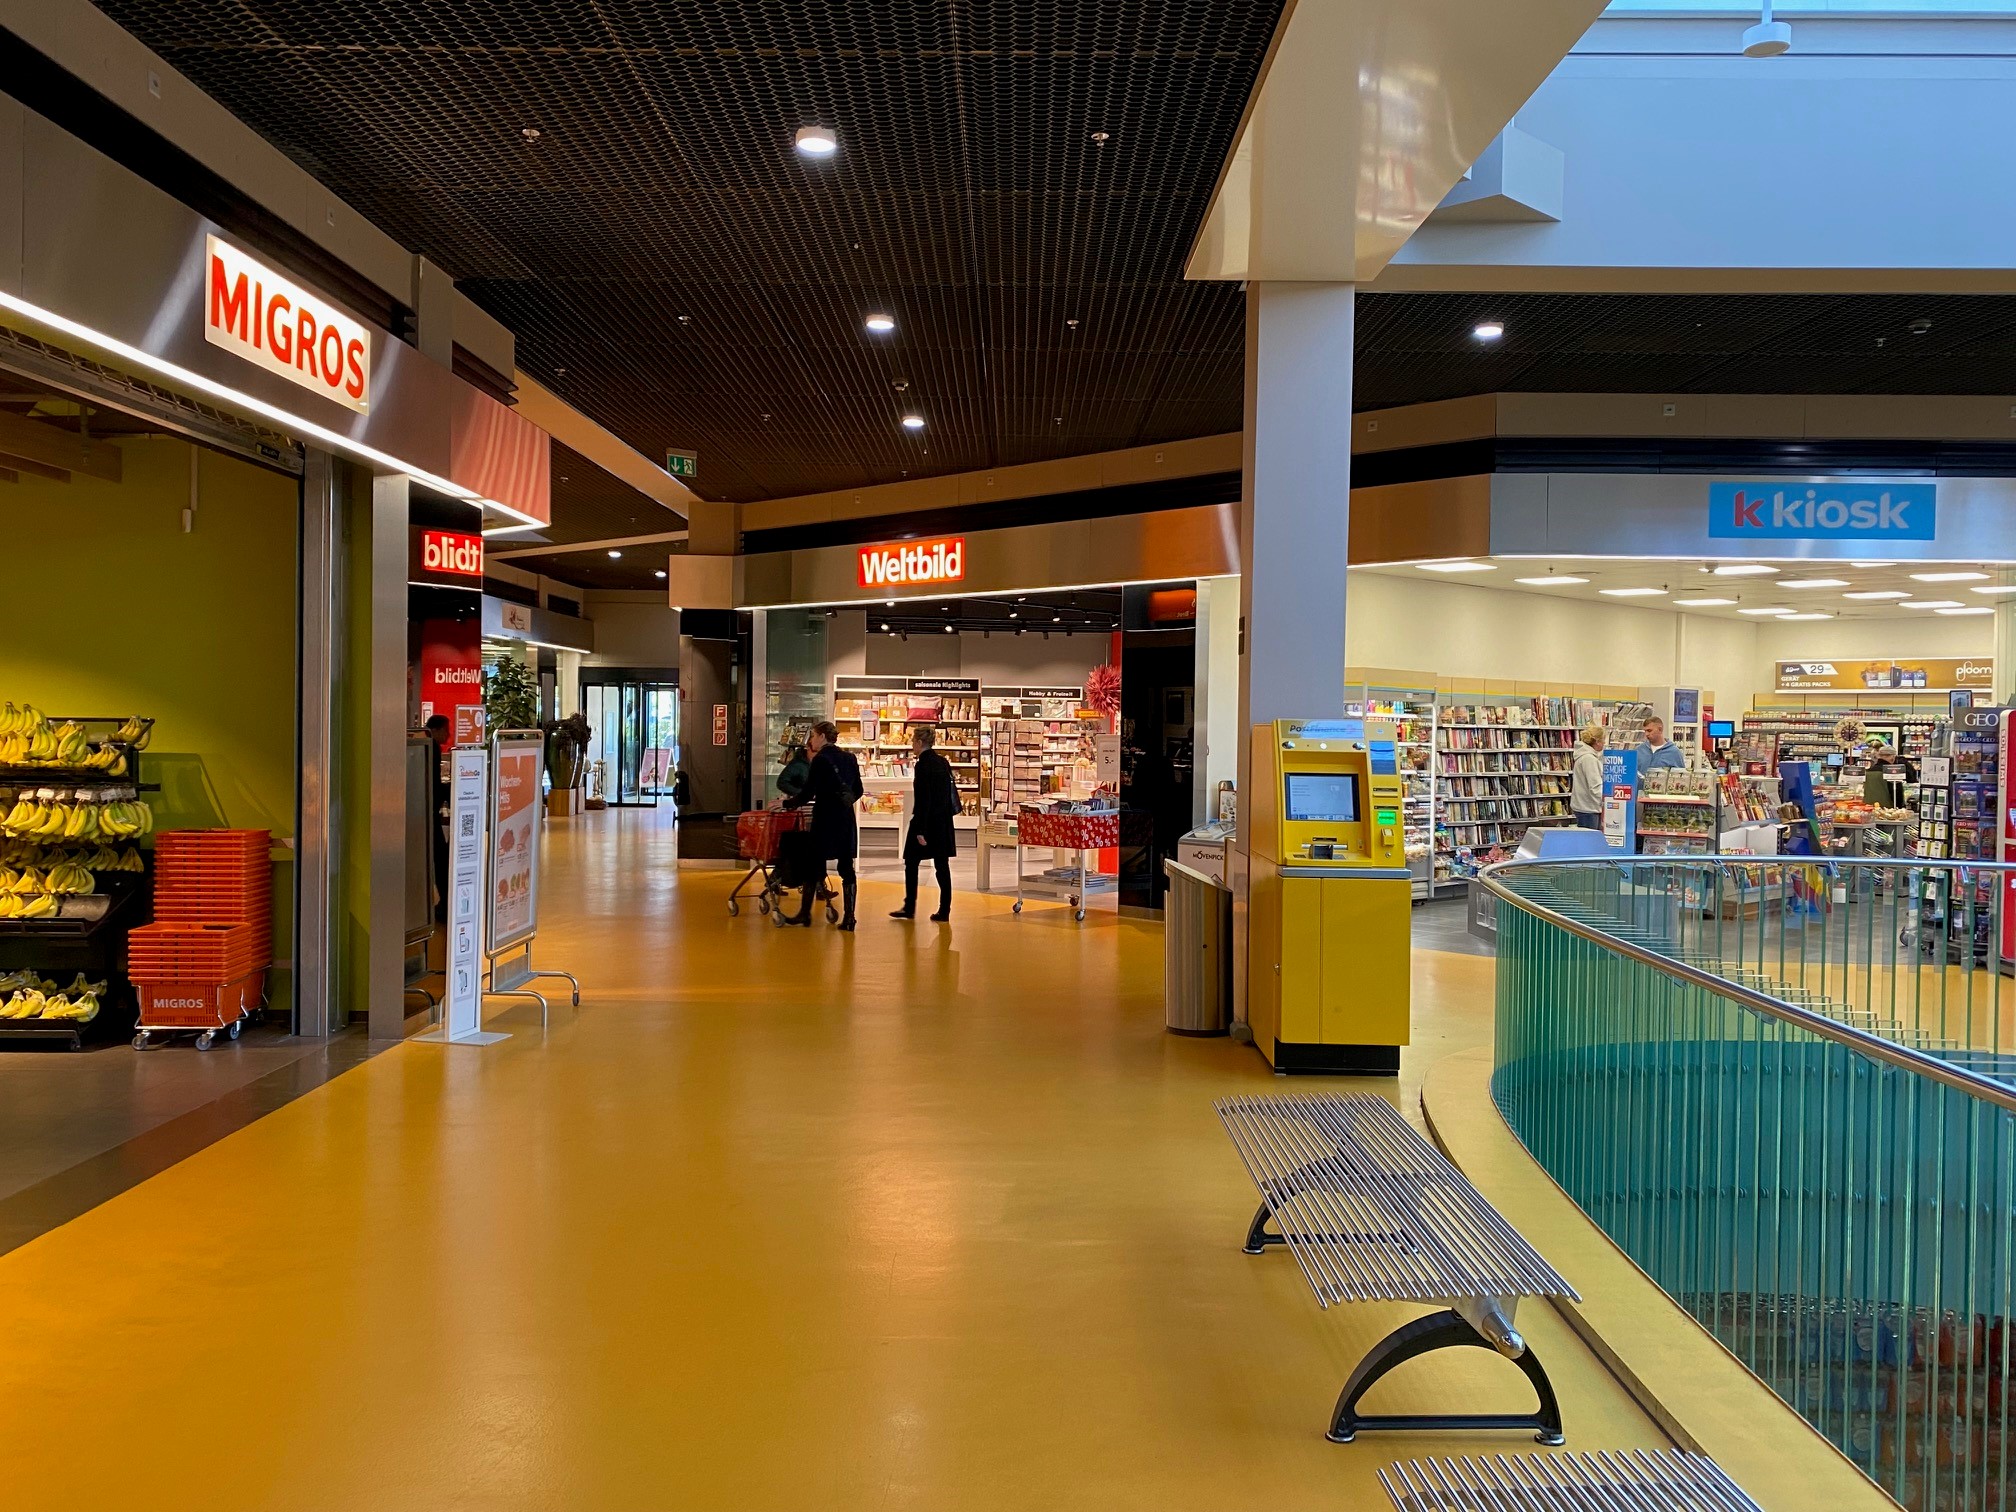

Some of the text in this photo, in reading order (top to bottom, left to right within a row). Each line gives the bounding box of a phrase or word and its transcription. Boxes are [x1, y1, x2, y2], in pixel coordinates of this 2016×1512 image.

[211, 254, 364, 398] MIGROS
[1734, 490, 1910, 529] k kiosk
[862, 542, 961, 583] Weltbild
[1810, 665, 1824, 673] 29
[1956, 661, 1993, 681] ploom
[717, 706, 724, 716] F
[1965, 713, 1999, 726] GEO
[1610, 765, 1627, 774] MORE
[153, 999, 204, 1008] MIGROS
